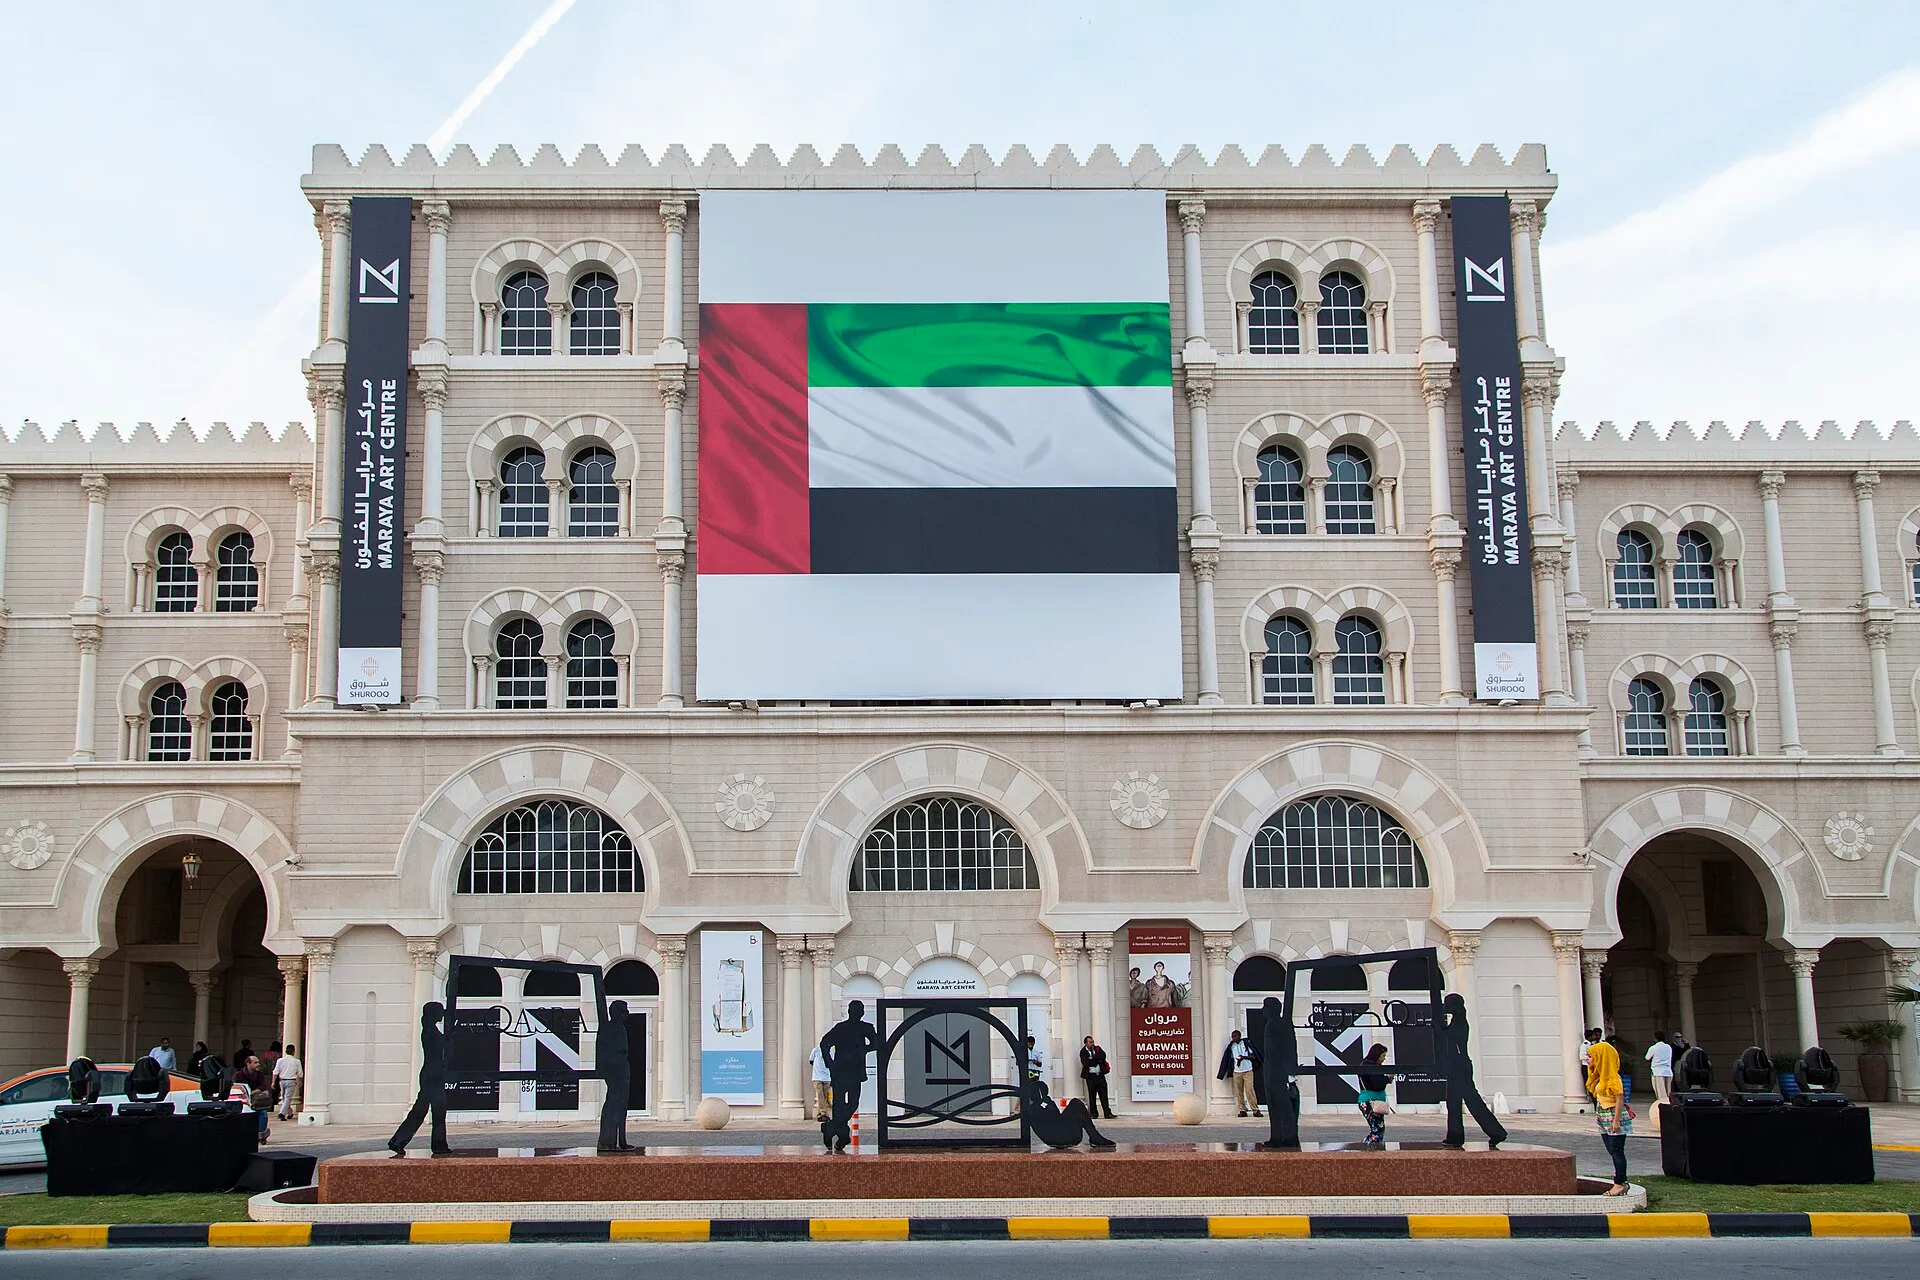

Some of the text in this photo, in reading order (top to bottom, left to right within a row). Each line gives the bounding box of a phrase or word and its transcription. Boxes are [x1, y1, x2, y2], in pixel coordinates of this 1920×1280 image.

[352, 378, 376, 569] مركز مرايا للفنون
[377, 379, 397, 569] MARAYA ART CENTRE
[1473, 376, 1499, 565] مركز مرايا للفنون
[1495, 376, 1520, 565] MARAYA ART CENTRE
[349, 690, 390, 698] SHUROOQ
[1485, 685, 1526, 693] SHUROOQ
[1144, 1013, 1178, 1025] مروان
[1138, 1028, 1185, 1037] تضاريس الروح
[1136, 1042, 1189, 1051] MARWAN:
[0, 1128, 28, 1136] ARJAH
